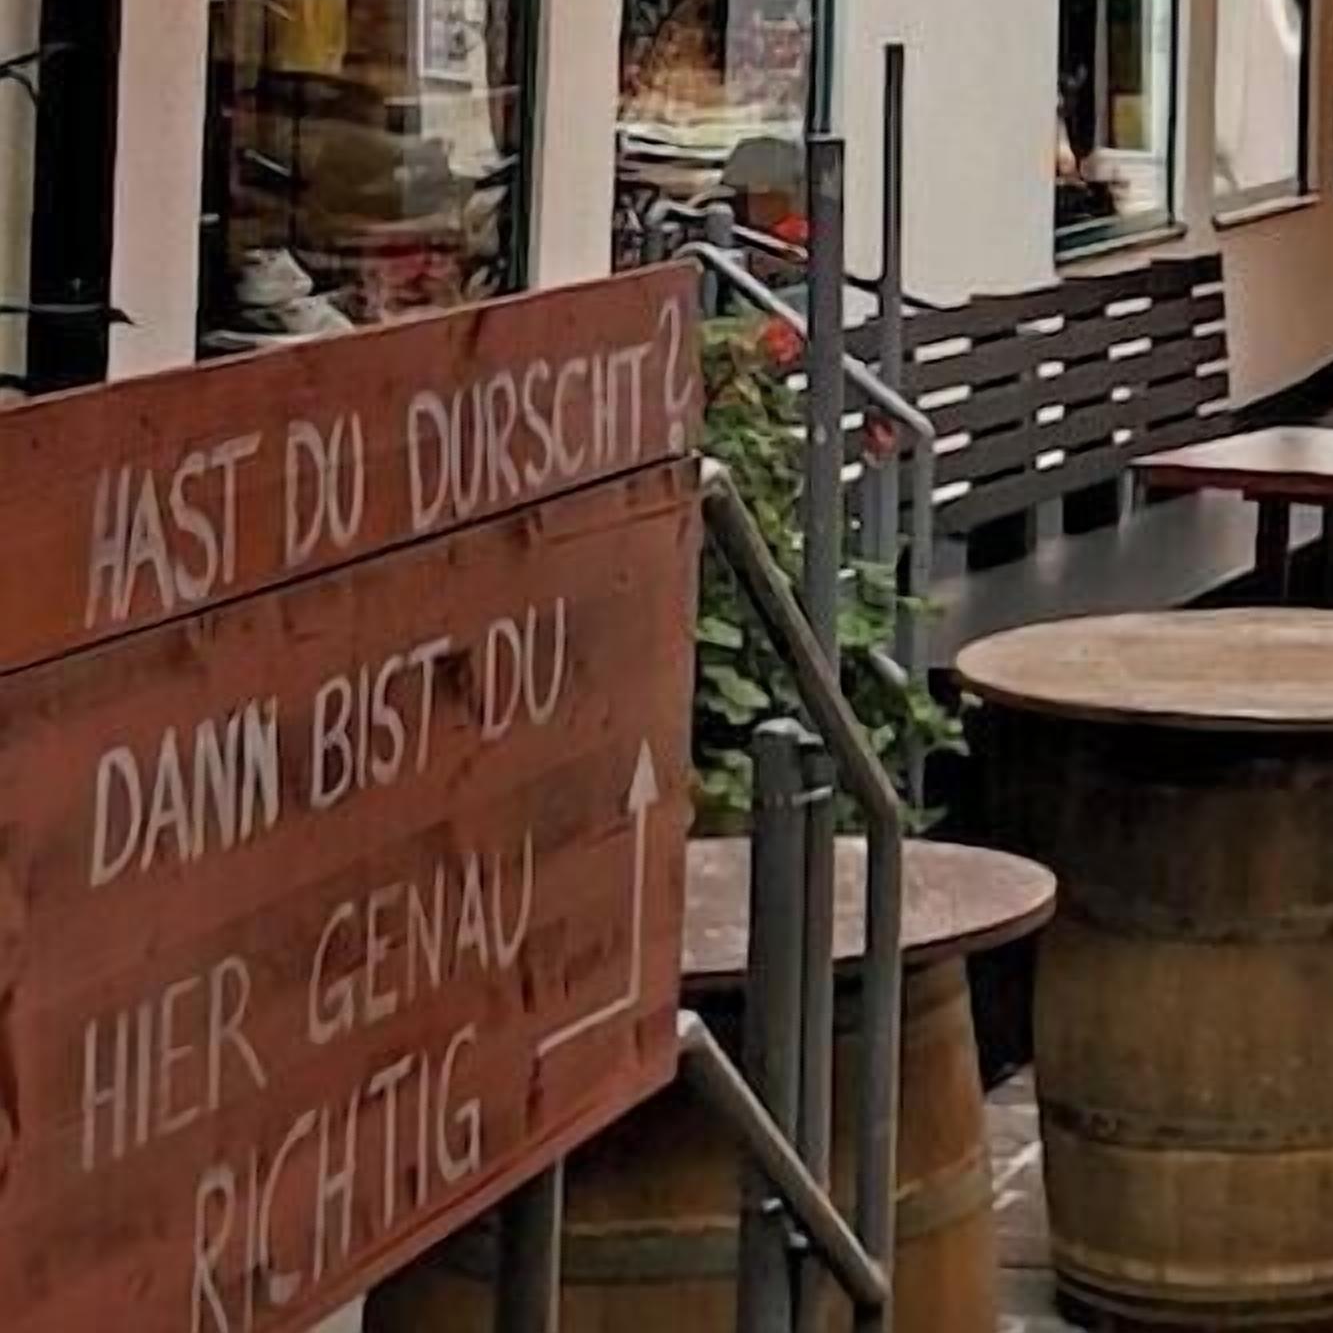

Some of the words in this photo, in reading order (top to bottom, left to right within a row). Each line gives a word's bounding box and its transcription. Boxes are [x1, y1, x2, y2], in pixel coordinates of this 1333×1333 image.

[85, 436, 262, 630] HAST
[286, 413, 365, 566] DU
[406, 299, 695, 533] DURSCHT?
[90, 695, 281, 889] DANN
[310, 636, 452, 811] BIST
[482, 596, 567, 743] DU
[82, 954, 268, 1174] HIER
[308, 825, 534, 1044] GENAU
[190, 1023, 483, 1333] RICHTIG
